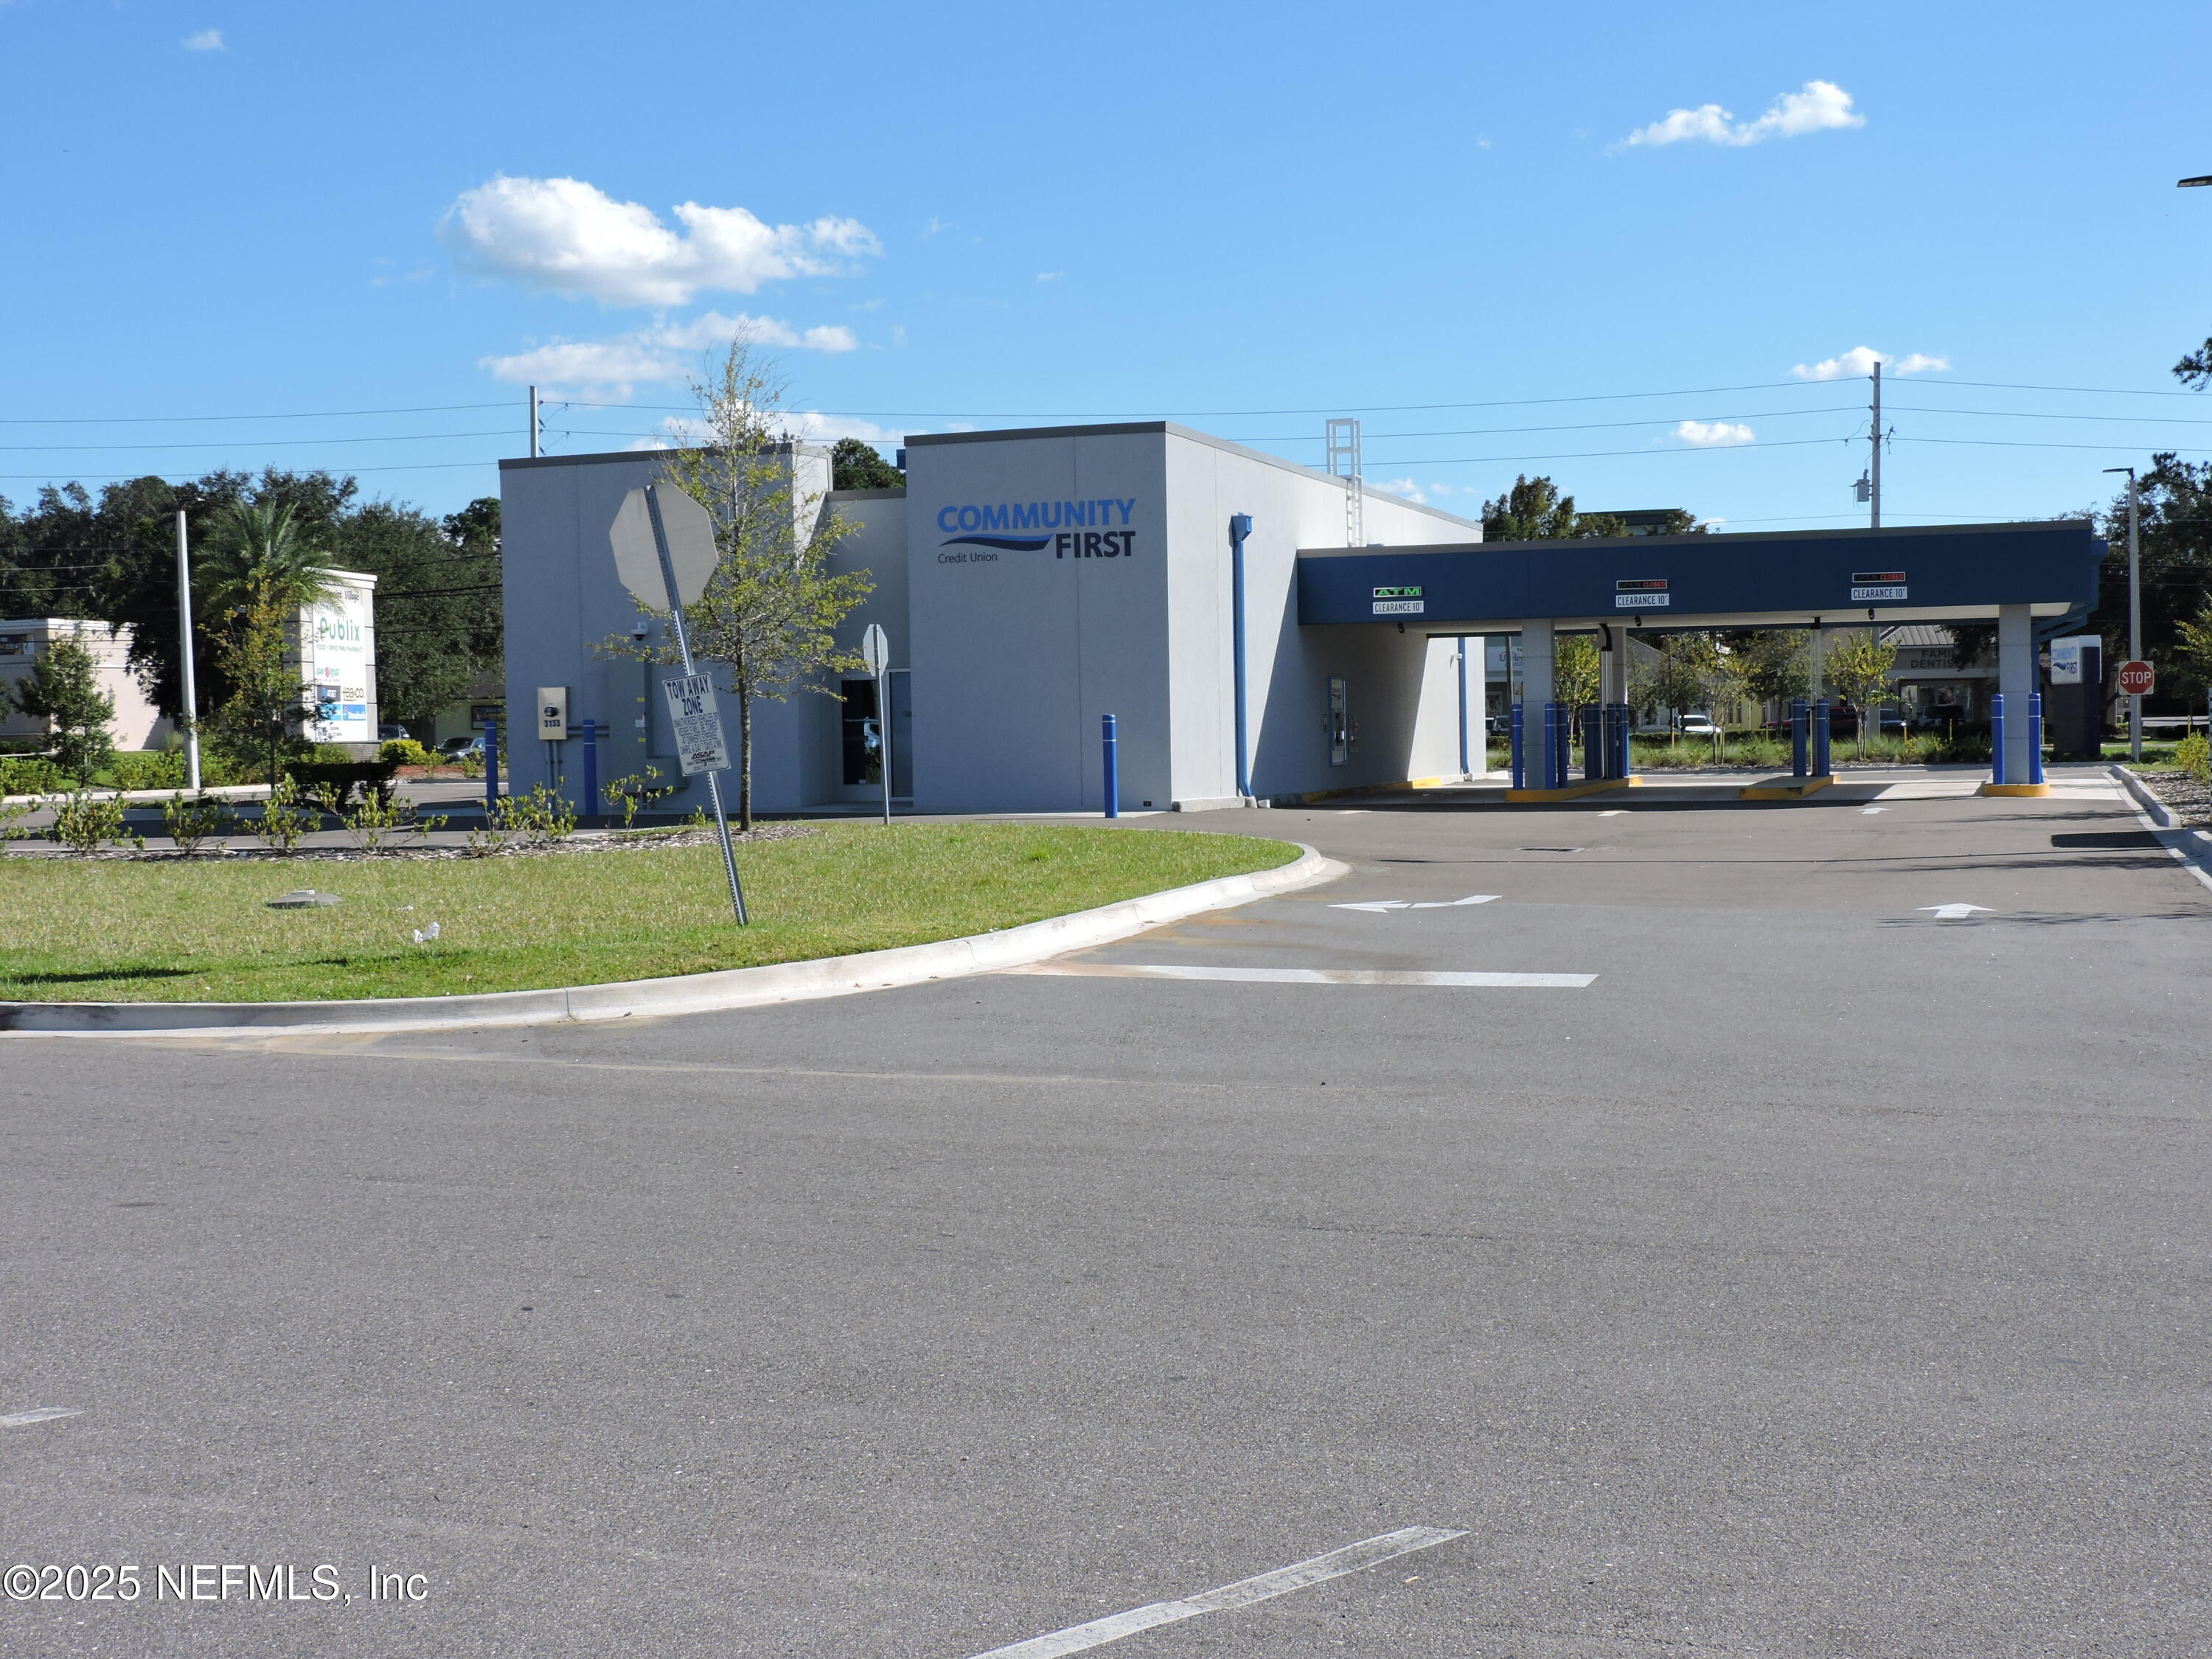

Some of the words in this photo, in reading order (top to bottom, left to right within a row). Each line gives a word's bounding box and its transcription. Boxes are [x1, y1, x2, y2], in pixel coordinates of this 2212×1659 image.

[937, 498, 1136, 533] COMMUNITY
[1055, 530, 1136, 559] FIRST
[937, 553, 968, 564] Credit
[970, 552, 998, 562] Union
[1642, 580, 1666, 588] CLOSED
[1377, 587, 1420, 596] ATM
[1853, 588, 1893, 599] CLEARANCE
[1896, 588, 1905, 598] 10'
[1618, 596, 1656, 606] CLEARANCE
[1658, 595, 1667, 605] 10'
[1374, 602, 1411, 613] CLEARANCE
[1413, 602, 1422, 611] 10'
[320, 616, 360, 641] Publix
[2065, 661, 2078, 675] FIRST
[2121, 672, 2152, 684] STOP
[667, 680, 686, 700] TOW
[687, 675, 709, 697] AWAY
[682, 695, 703, 716] ZONE
[544, 719, 560, 728] 3133
[691, 750, 715, 759] ASAP
